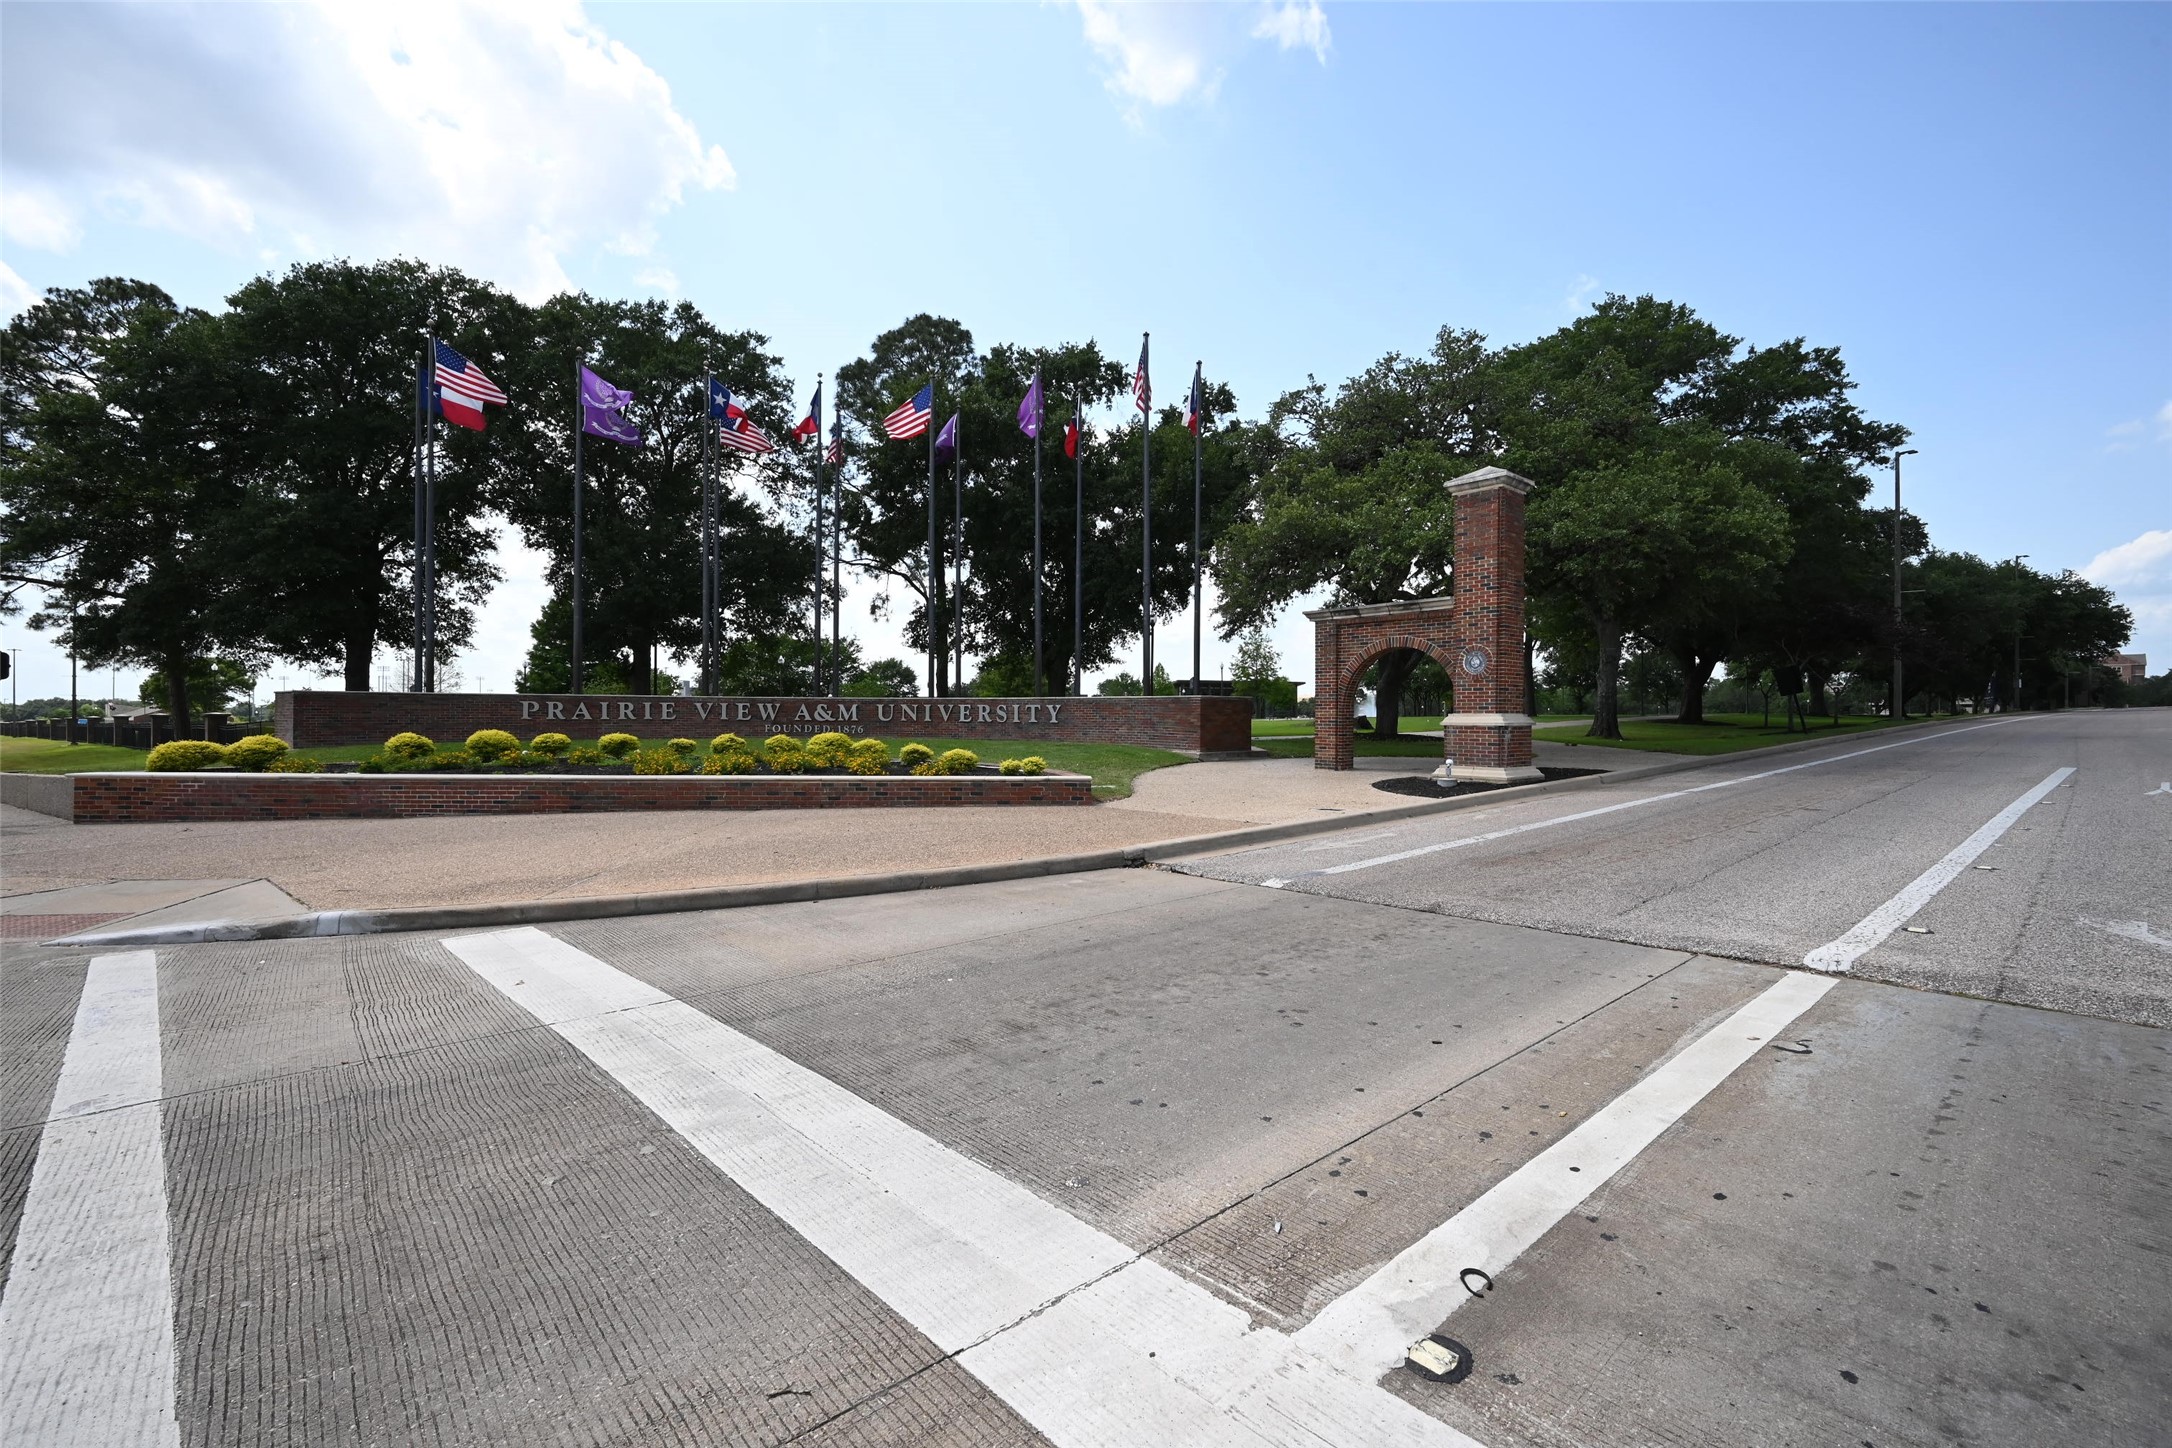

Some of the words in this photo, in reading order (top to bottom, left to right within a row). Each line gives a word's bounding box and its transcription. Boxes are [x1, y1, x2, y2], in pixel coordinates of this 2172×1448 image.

[520, 699, 677, 720] PRAIRIE
[694, 702, 781, 721] VIEW
[795, 703, 859, 721] A&M
[877, 704, 1062, 724] UNIVERSITY
[764, 724, 831, 733] FOUNDED
[838, 725, 864, 734] 1876
